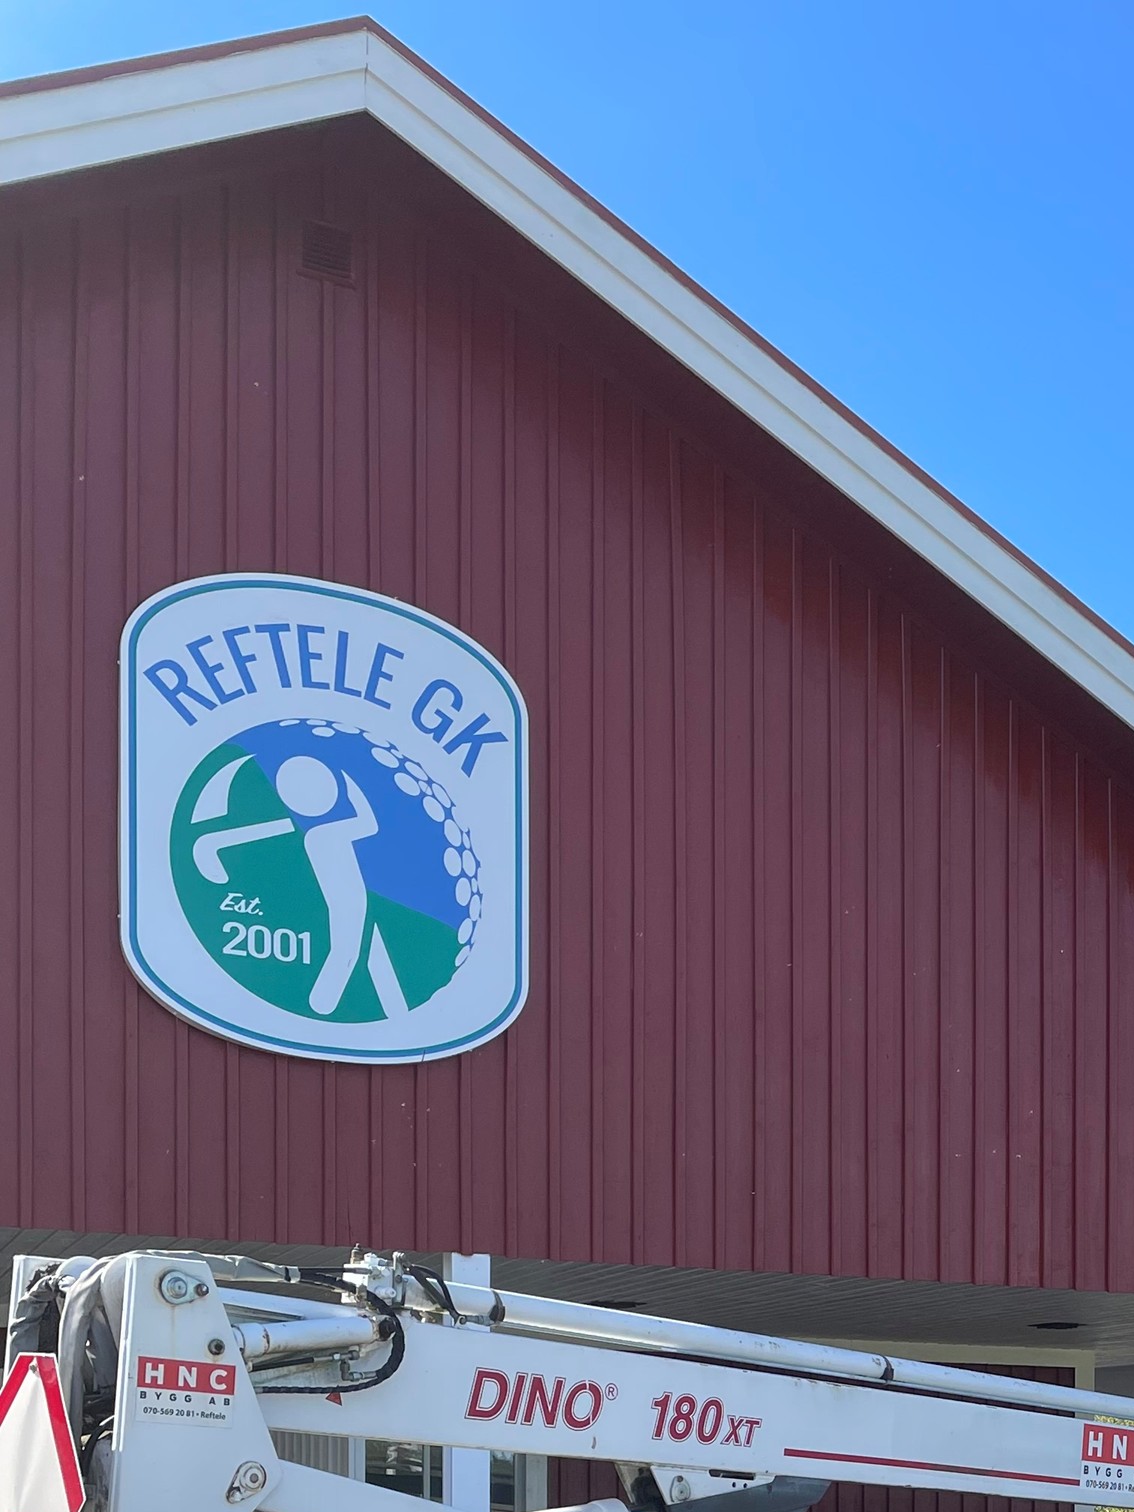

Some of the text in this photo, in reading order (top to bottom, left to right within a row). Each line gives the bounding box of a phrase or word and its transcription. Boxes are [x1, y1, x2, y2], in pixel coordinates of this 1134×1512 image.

[143, 623, 509, 778] REFTELE GK
[219, 892, 264, 916] Est.
[221, 921, 312, 965] 2001
[144, 1362, 228, 1391] HNC
[139, 1390, 231, 1406] BYGG AB
[143, 1406, 175, 1416] 070-569
[200, 1411, 226, 1420] Reftele
[1083, 1465, 1123, 1478] BYGG
